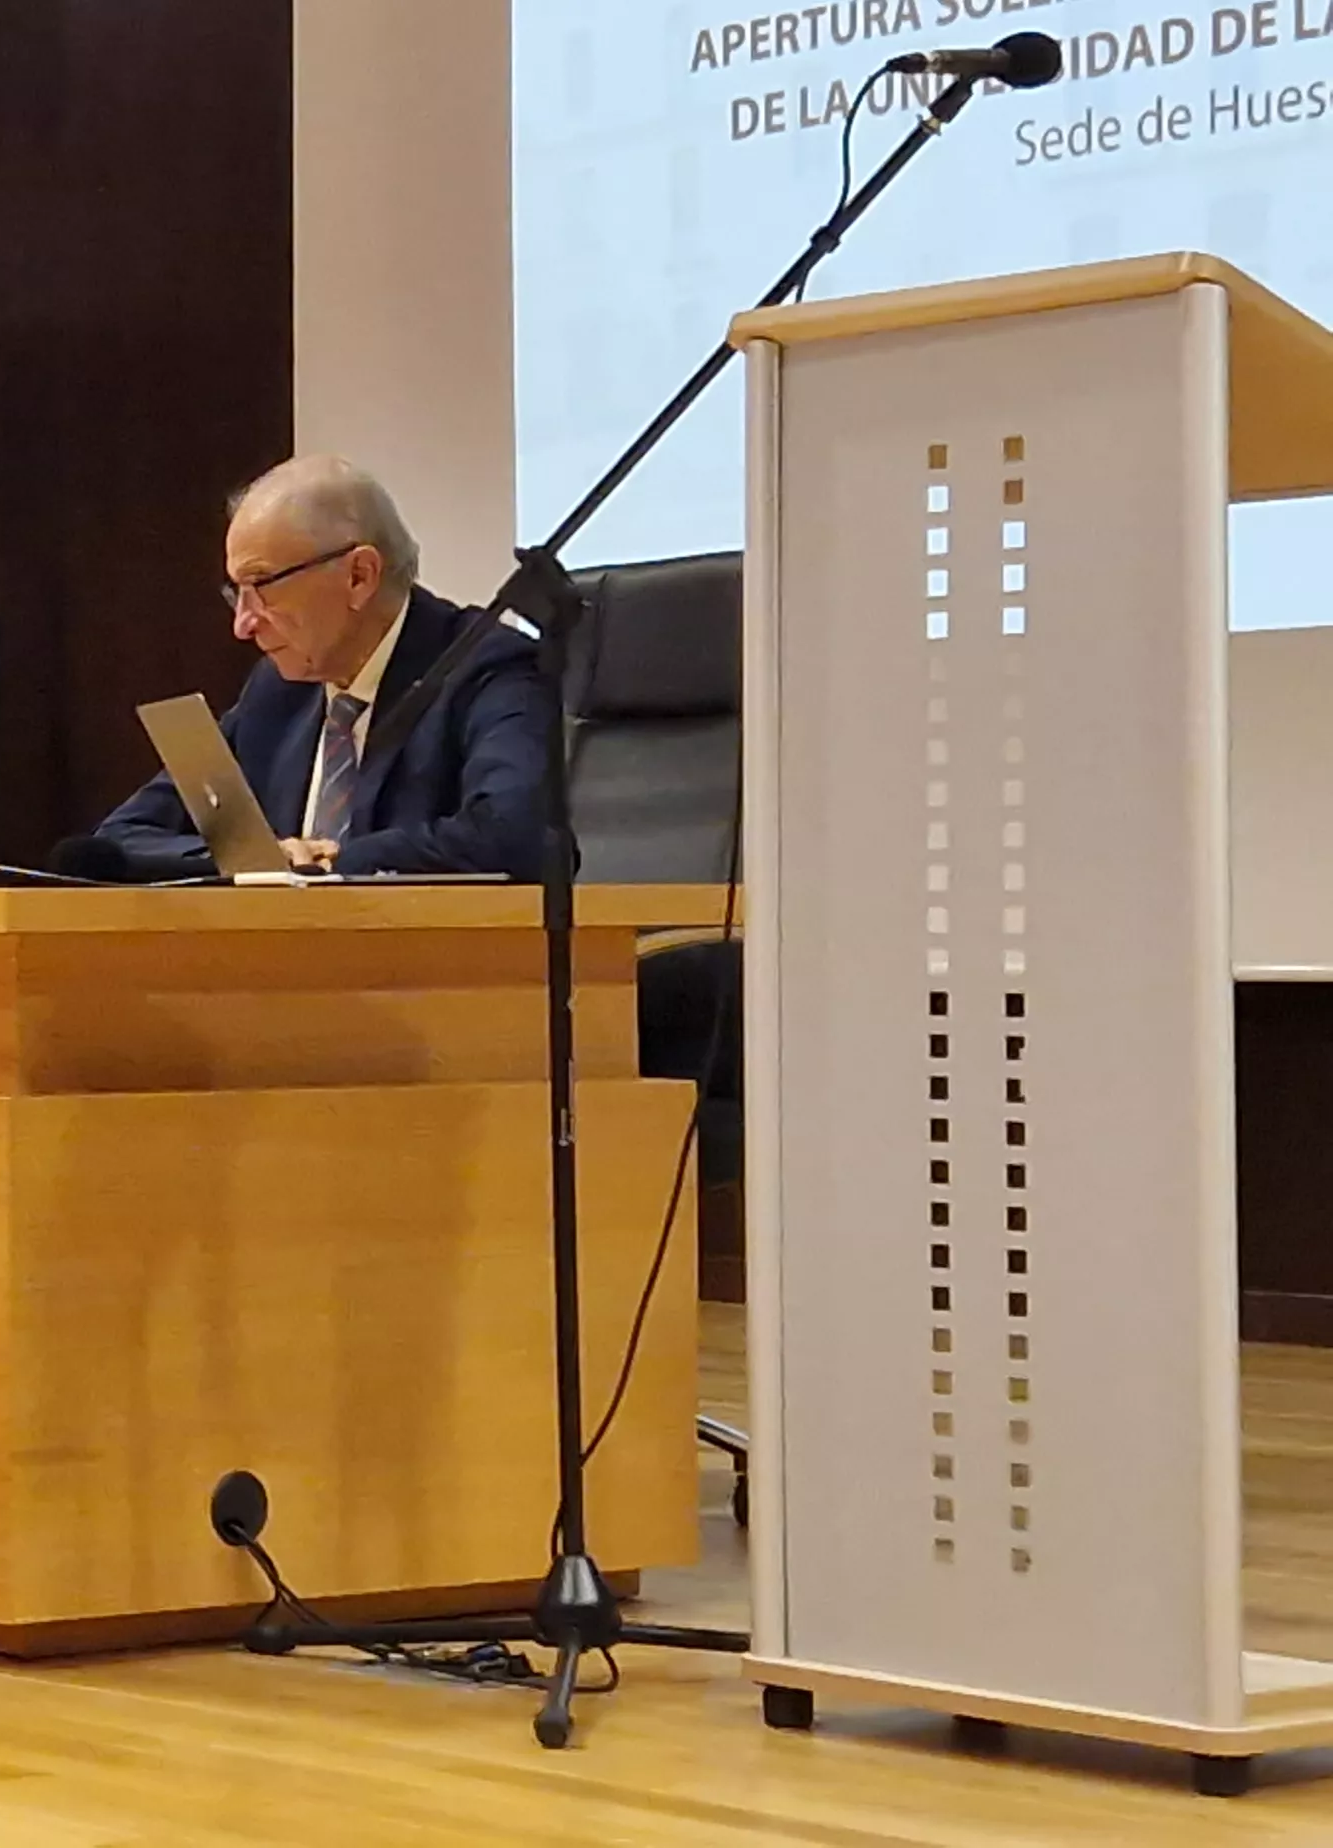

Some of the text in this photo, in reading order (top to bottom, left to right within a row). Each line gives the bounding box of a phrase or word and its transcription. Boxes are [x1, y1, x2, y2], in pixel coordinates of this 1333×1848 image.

[690, 0, 922, 72] APERTURA
[731, 91, 786, 140] DE
[800, 79, 851, 127] LA
[1210, 2, 1278, 57] DE
[1015, 80, 1333, 166] Sede de Hues
